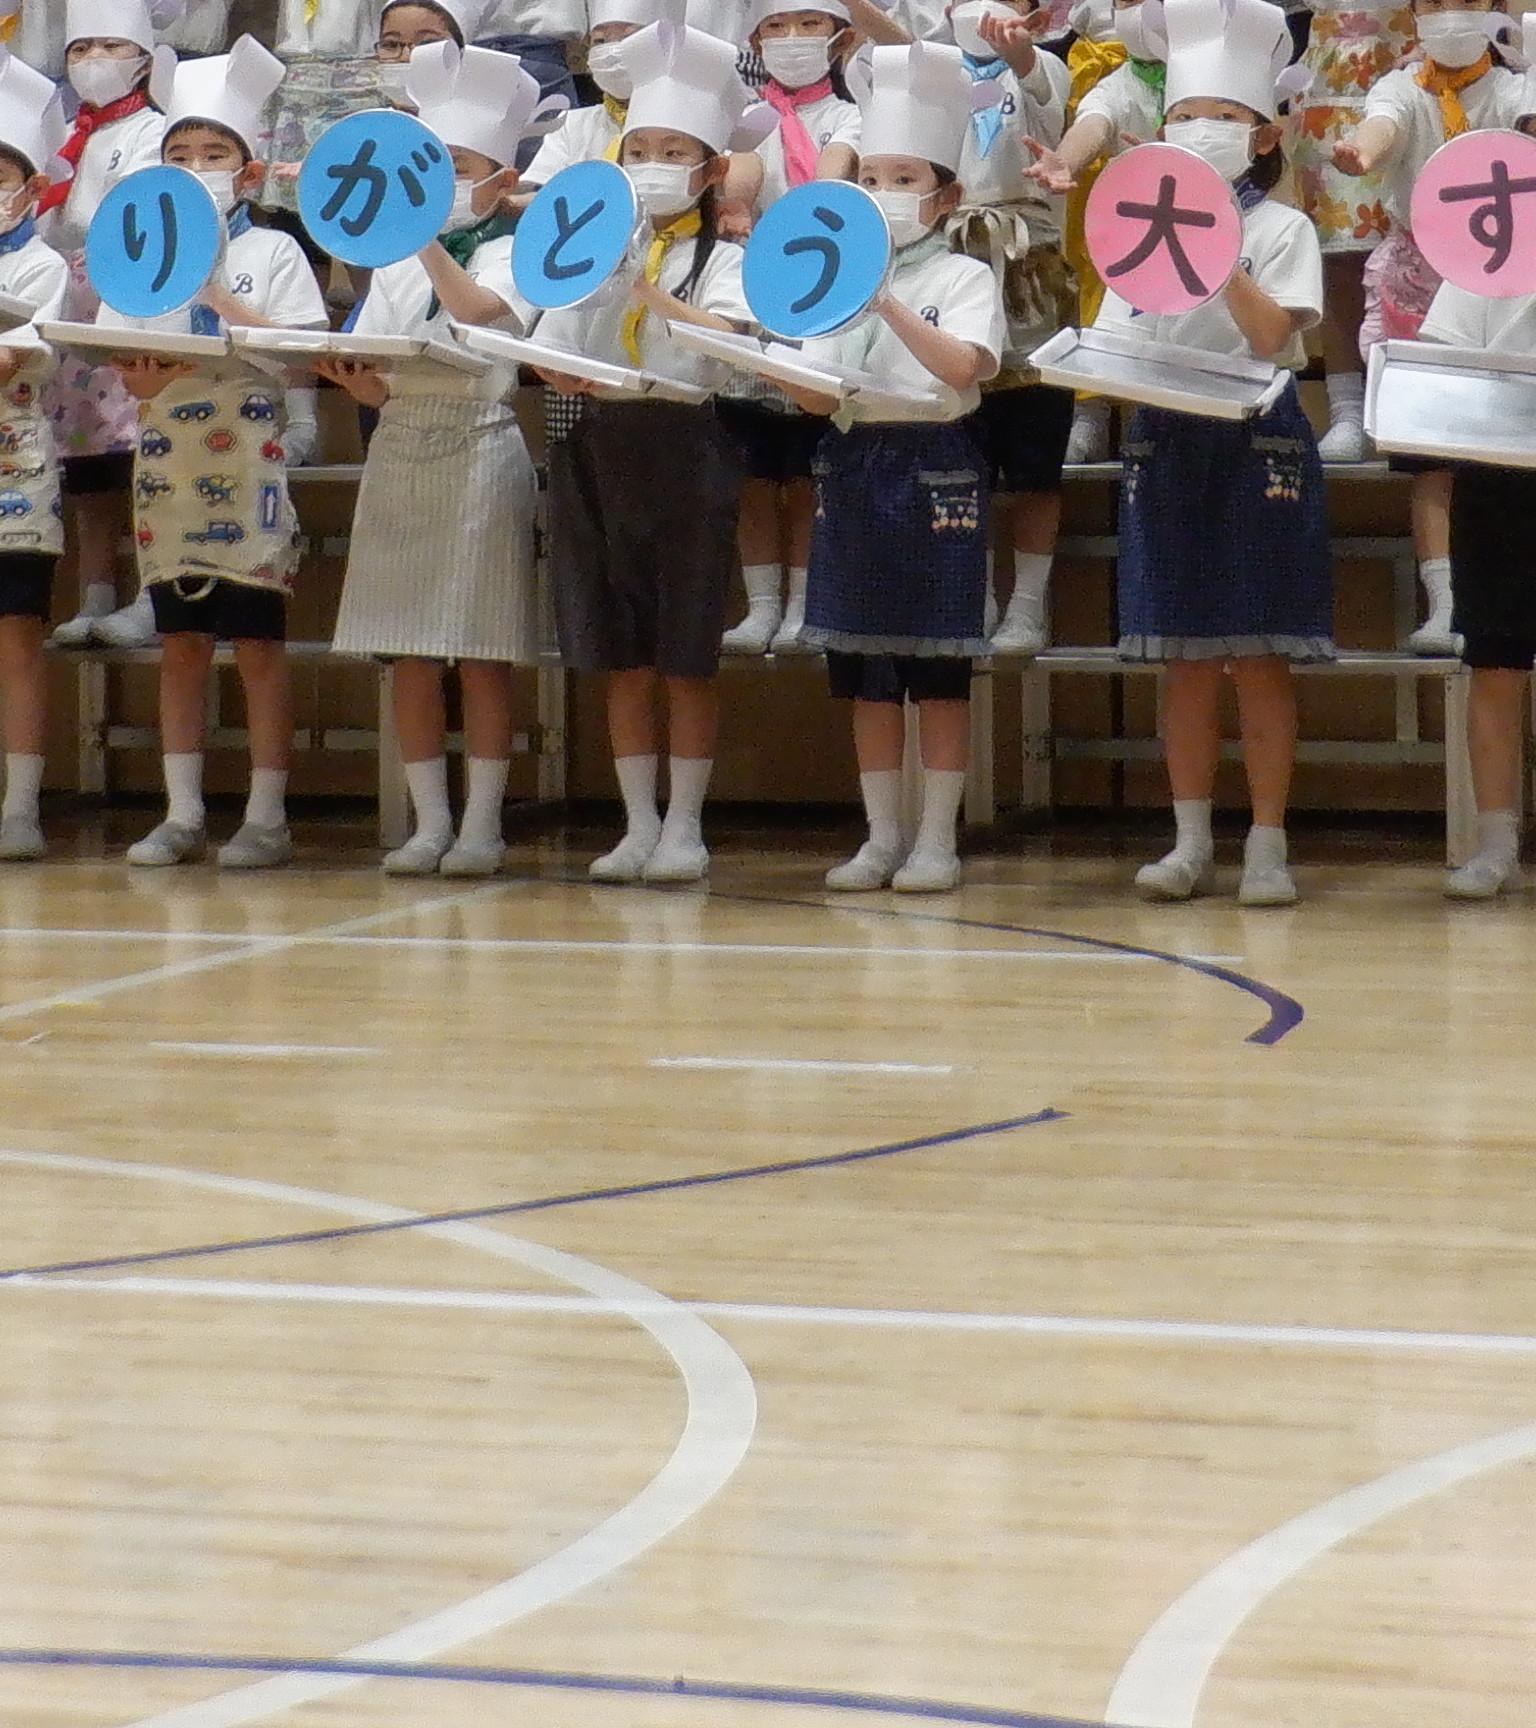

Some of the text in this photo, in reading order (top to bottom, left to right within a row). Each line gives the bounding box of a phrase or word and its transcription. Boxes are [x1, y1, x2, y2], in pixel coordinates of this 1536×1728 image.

[122, 191, 178, 292] り
[320, 138, 442, 237] が
[542, 196, 605, 280] と
[782, 205, 846, 314] う
[231, 272, 254, 295] B
[1105, 174, 1216, 296] 大
